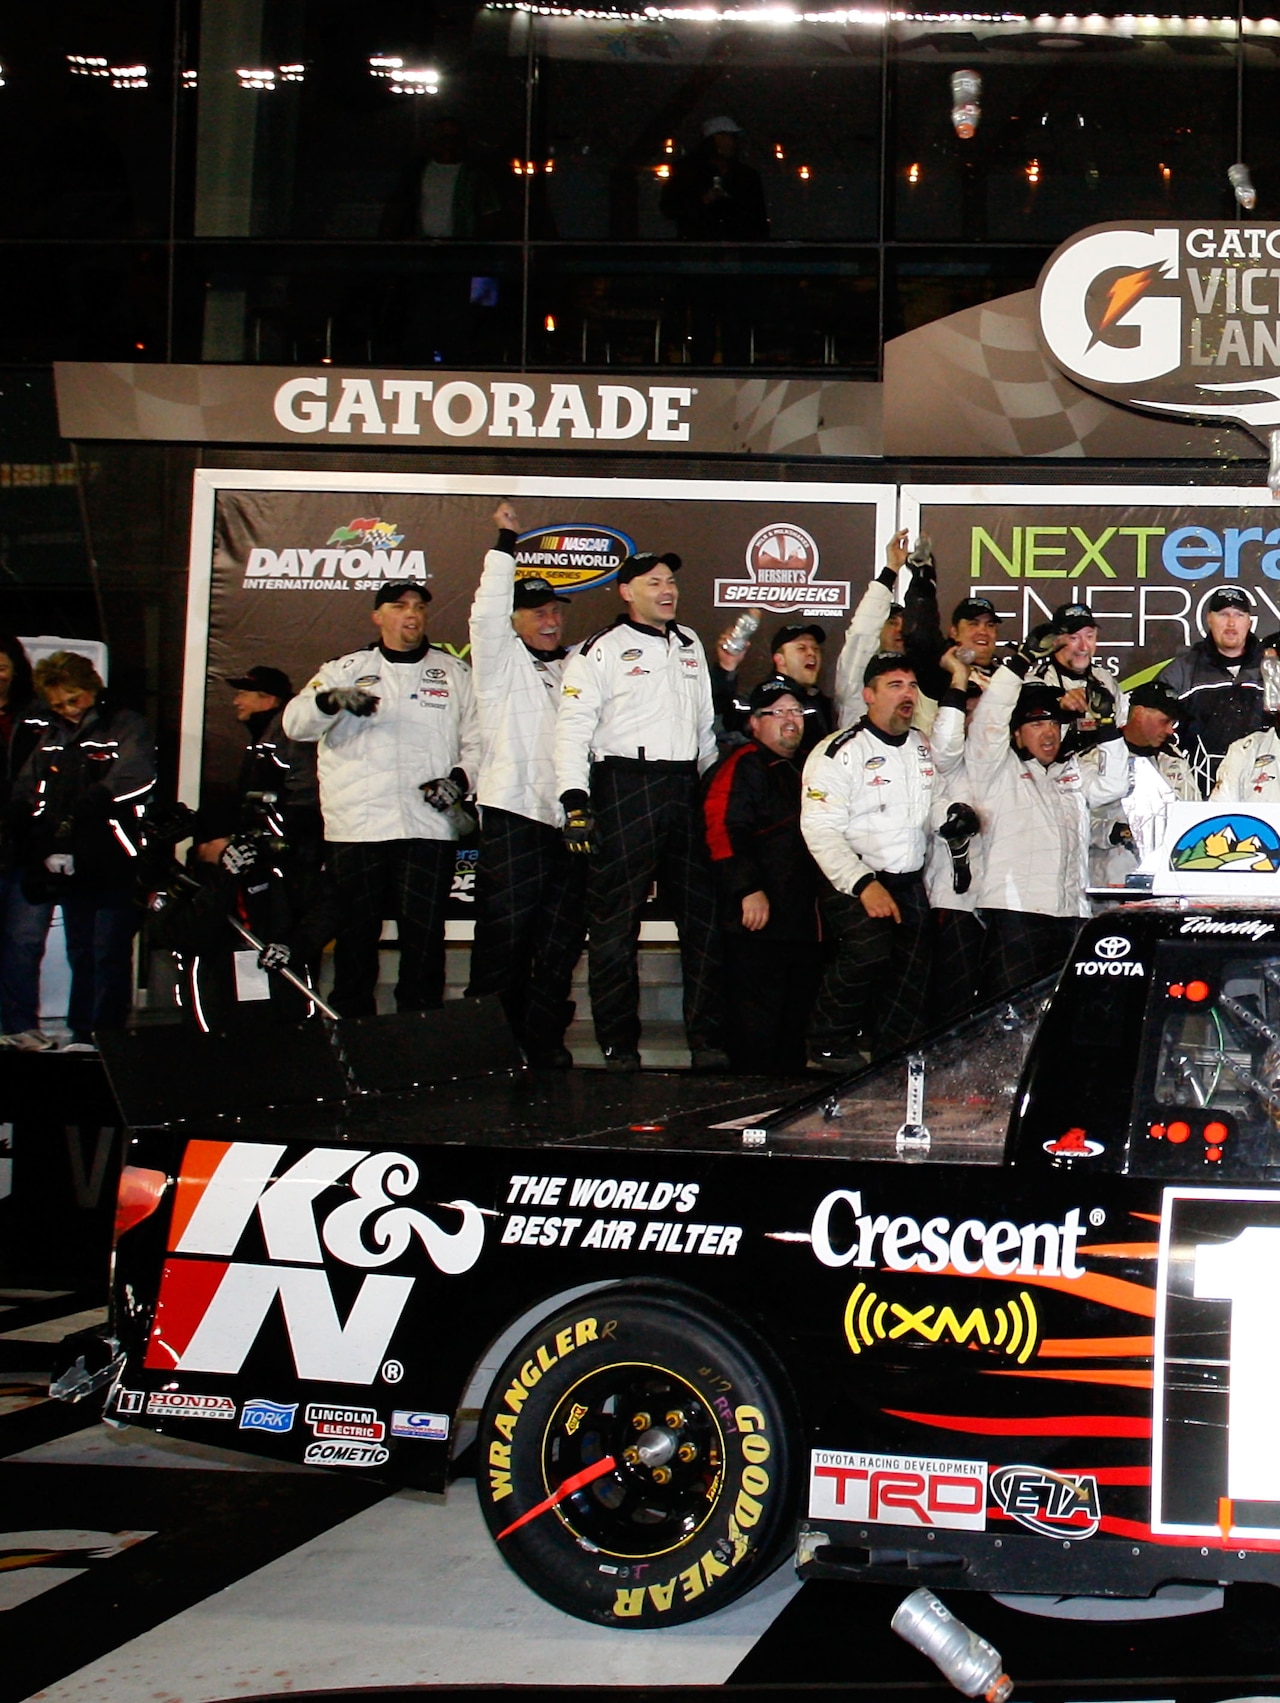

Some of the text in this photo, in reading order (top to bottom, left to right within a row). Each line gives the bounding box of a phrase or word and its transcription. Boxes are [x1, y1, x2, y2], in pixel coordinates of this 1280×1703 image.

[274, 376, 690, 442] GATORADE
[562, 537, 610, 551] NASCAR
[245, 548, 427, 578] DAYTONA
[514, 551, 620, 567] AMPING WORLD
[515, 570, 581, 579] RUCK SERIES
[757, 569, 806, 584] HERSHEY'S
[243, 578, 350, 591] INTERNATIONAL
[725, 586, 840, 602] SPEEDWEEKS
[1180, 915, 1276, 941] Timothy
[1075, 962, 1144, 977] TOYOTA
[506, 1175, 700, 1213] THE WORLD'S
[501, 1215, 743, 1256] BEST AIR FILTER
[811, 1189, 1087, 1279] Crescent
[149, 1393, 235, 1409] HONDA
[489, 1317, 601, 1502] WRANGLER
[147, 1407, 234, 1418] GENERATORS
[245, 1410, 286, 1428] TORK
[310, 1408, 372, 1424] LINCOLN
[322, 1424, 375, 1438] ELECTRIC
[306, 1443, 388, 1463] COMETIC
[815, 1453, 983, 1475] TOYOTA RACING DEVELOPMENT
[814, 1466, 983, 1524] TRD
[1005, 1474, 1101, 1519] ETA
